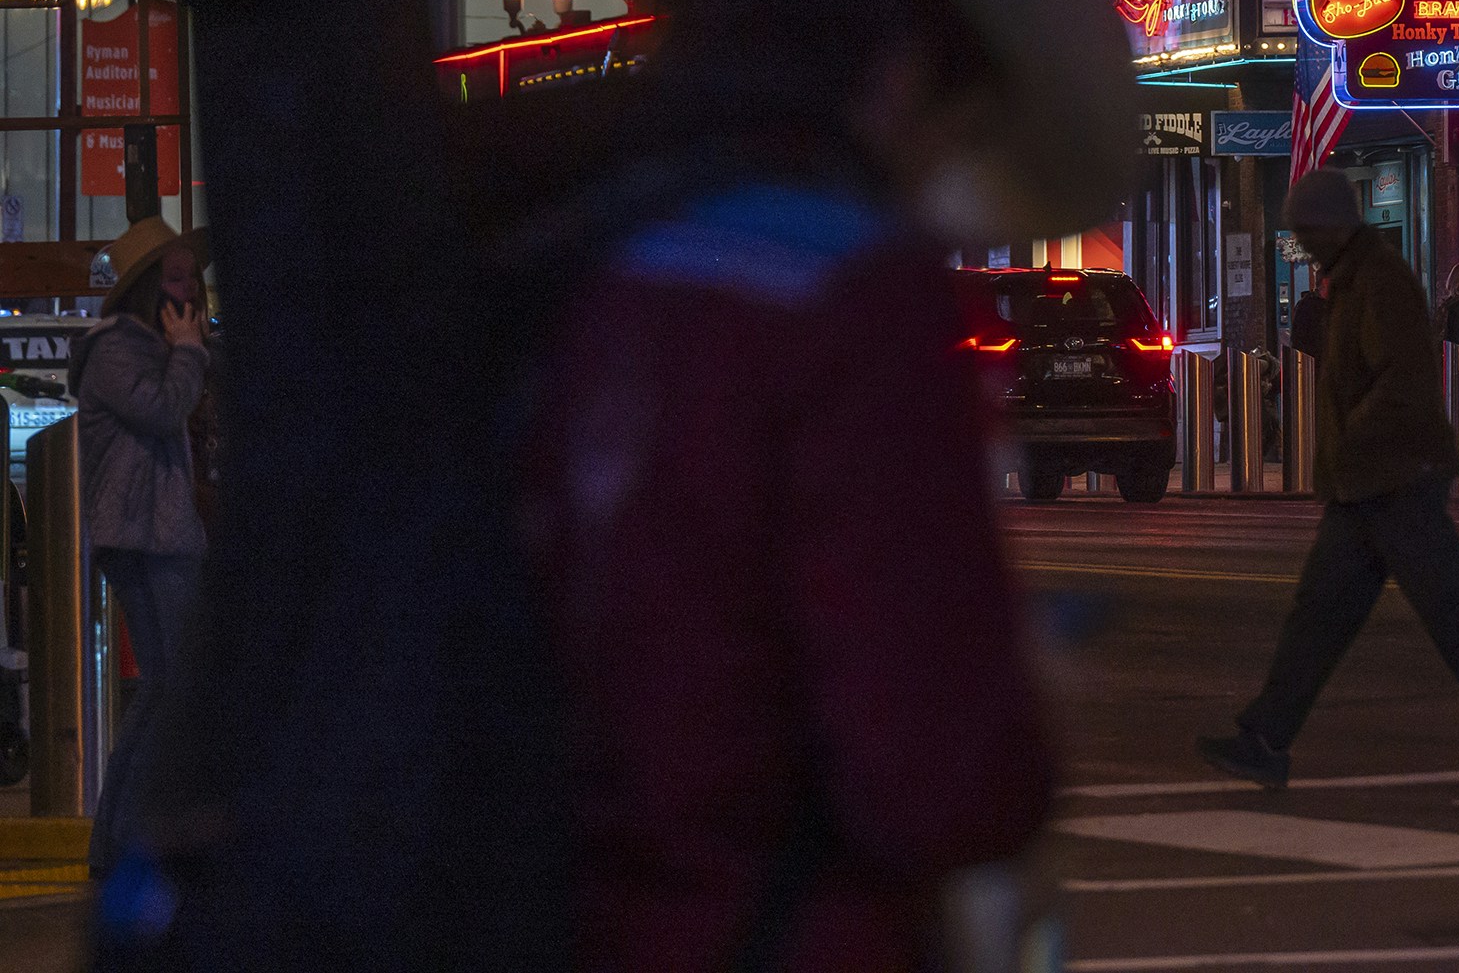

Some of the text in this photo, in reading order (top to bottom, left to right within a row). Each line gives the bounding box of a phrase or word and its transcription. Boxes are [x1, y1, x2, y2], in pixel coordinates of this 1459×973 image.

[1391, 23, 1447, 45] Honky
[86, 44, 129, 62] Ryman
[86, 65, 158, 80] Auditorim
[1154, 112, 1202, 143] FIDDLE
